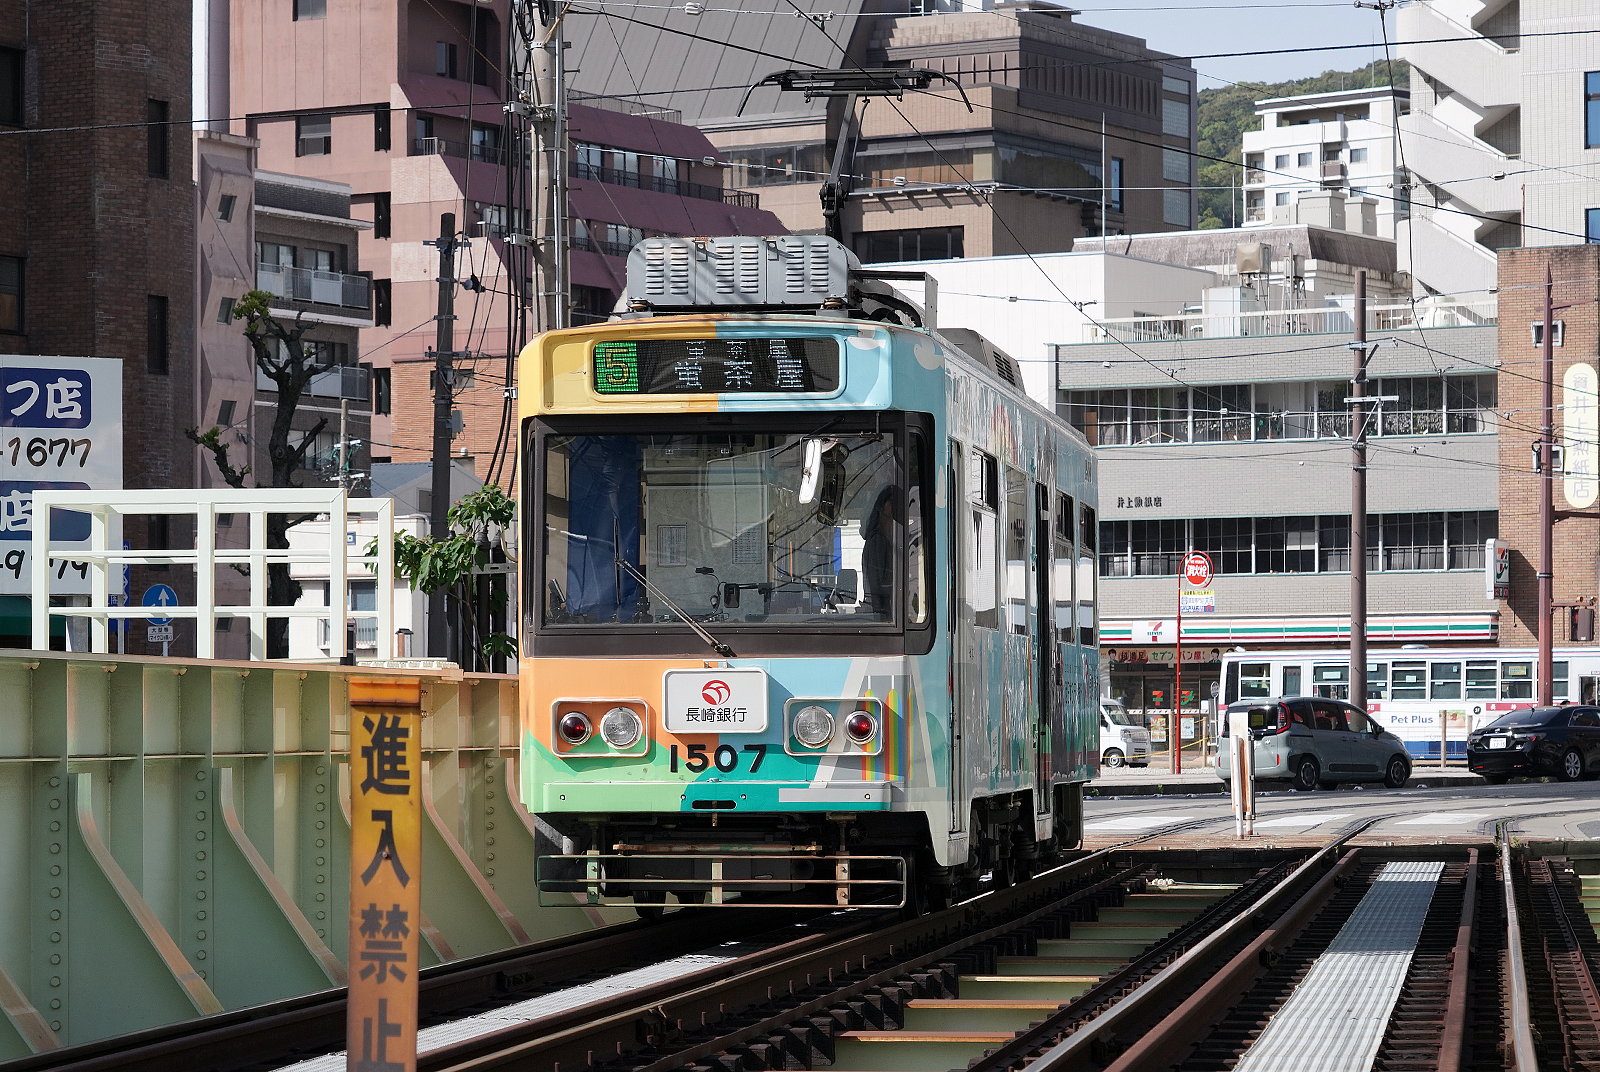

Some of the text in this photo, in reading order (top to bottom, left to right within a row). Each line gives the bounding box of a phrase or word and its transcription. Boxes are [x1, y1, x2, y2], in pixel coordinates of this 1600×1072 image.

[605, 348, 629, 385] 5
[1186, 564, 1208, 578] 消火栓
[686, 707, 748, 723] 長崎銀行
[1390, 715, 1434, 724] Pet Plus
[670, 744, 767, 773] 1507
[358, 712, 411, 1072] 進入禁止
